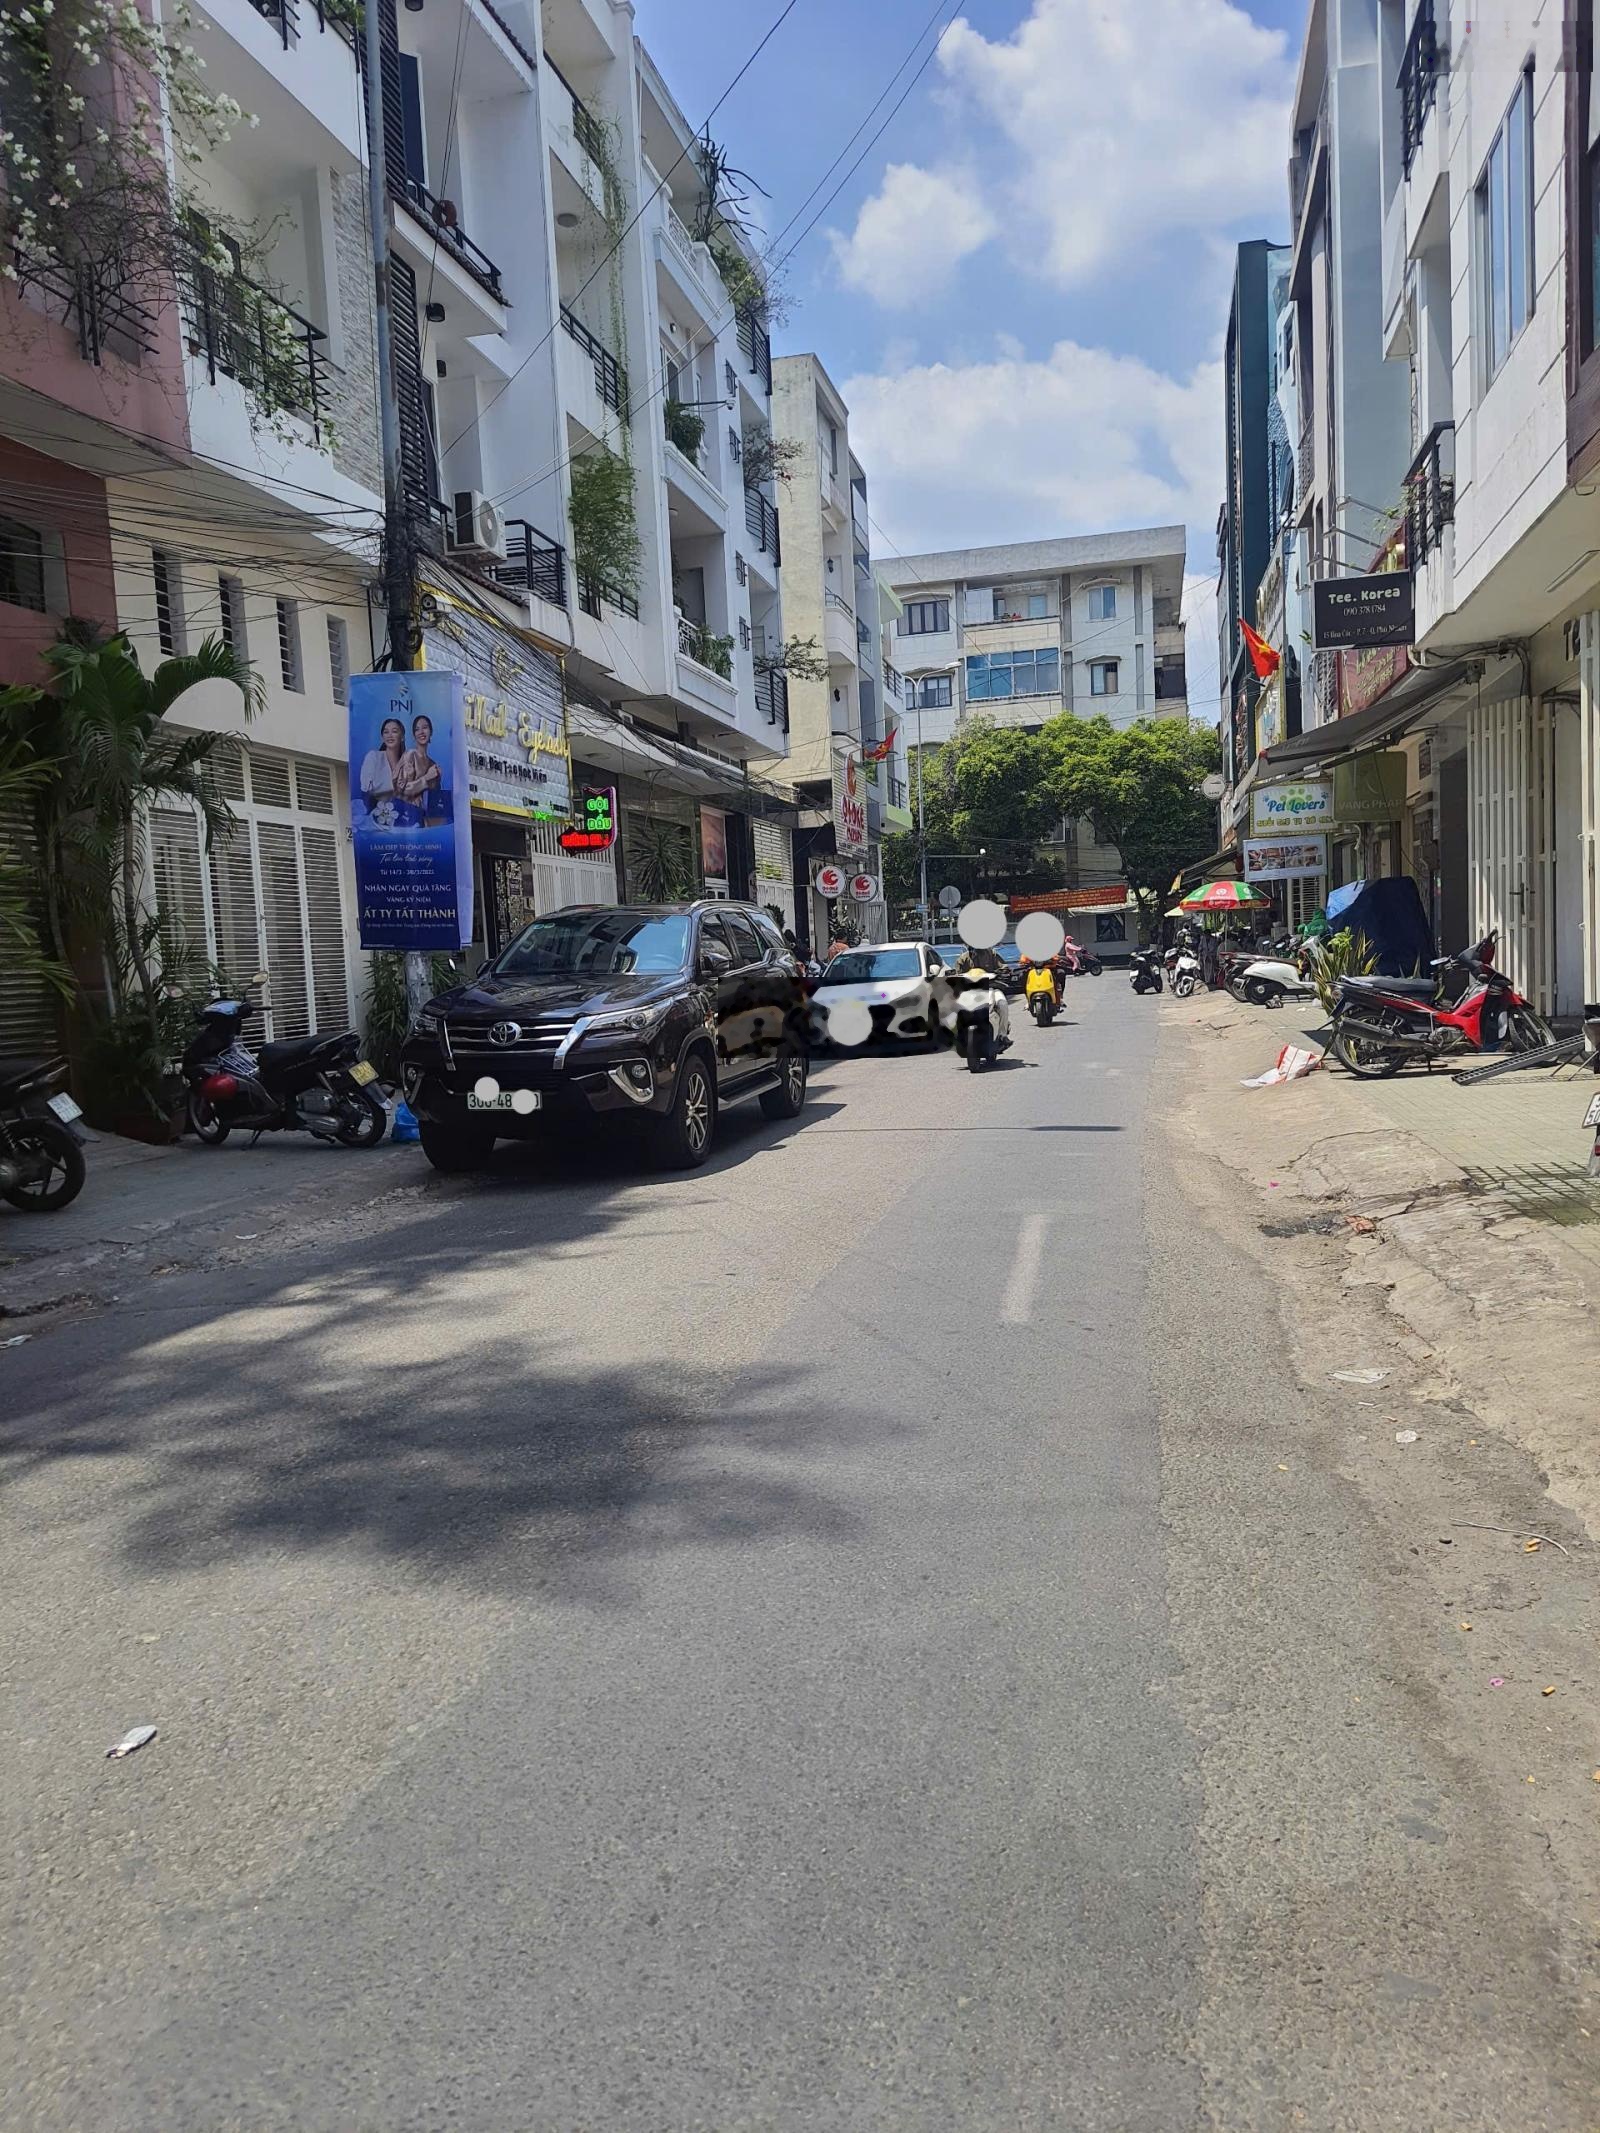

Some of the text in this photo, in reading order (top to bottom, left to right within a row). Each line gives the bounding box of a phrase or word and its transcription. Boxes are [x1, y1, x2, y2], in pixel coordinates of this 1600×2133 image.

[1361, 587, 1400, 600] Korea
[390, 700, 413, 713] PNJ
[1267, 799, 1325, 814] Pet Lovers
[389, 884, 410, 892] NGAY
